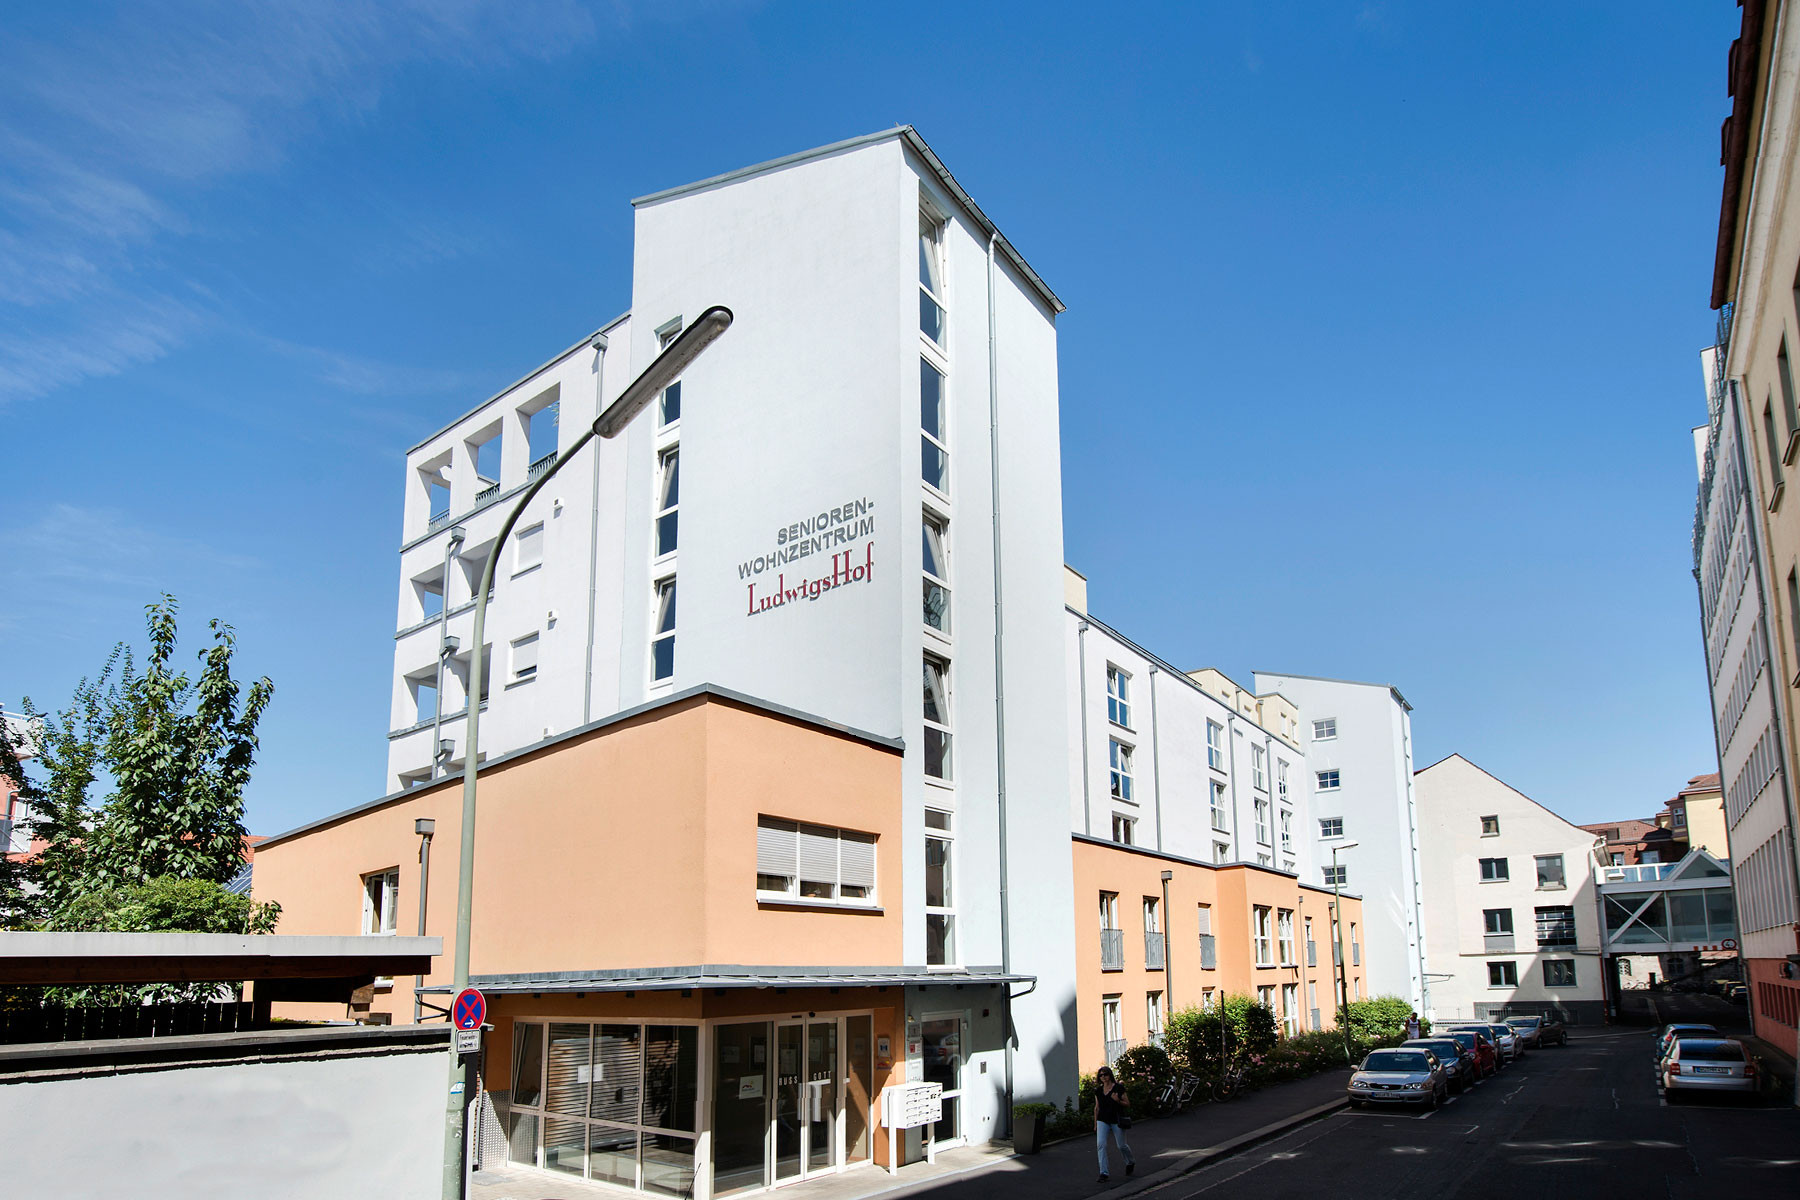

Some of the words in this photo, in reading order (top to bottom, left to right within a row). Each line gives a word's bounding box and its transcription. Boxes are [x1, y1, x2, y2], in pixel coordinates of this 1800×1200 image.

[738, 516, 874, 580] WOHNZENTRUM
[777, 497, 874, 545] SENIOREN-
[747, 541, 874, 617] LudwigsHof
